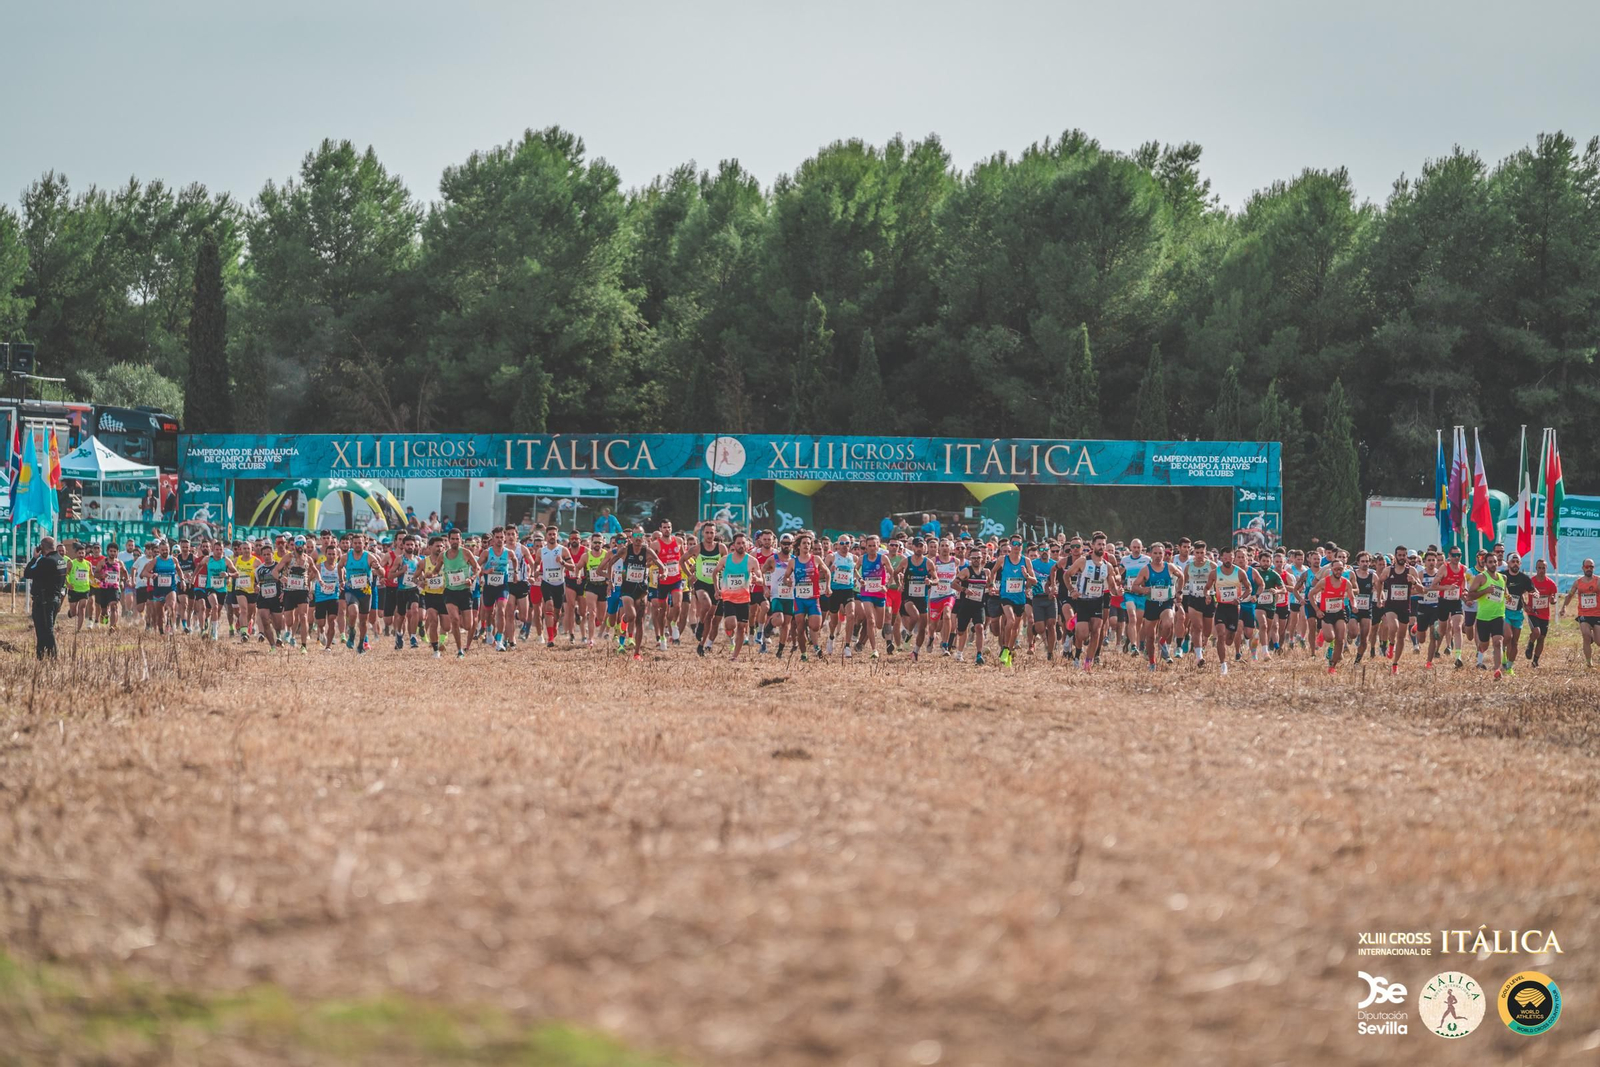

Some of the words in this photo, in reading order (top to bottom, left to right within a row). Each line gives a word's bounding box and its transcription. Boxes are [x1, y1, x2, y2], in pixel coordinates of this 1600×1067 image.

[253, 447, 300, 456] ANDALUCÍA
[331, 440, 410, 468] XLIII
[412, 440, 476, 458] CROSS
[504, 434, 658, 470] ITÁLICA
[850, 444, 916, 460] CROSS
[768, 442, 850, 470] XLIII
[944, 438, 1098, 476] ITÁLICA
[1152, 455, 1208, 463] CAMPEONATO
[1220, 454, 1268, 464] ANDALUCÍA
[412, 458, 499, 468] INTERNACIONAL
[851, 460, 938, 472] INTERNACIONAL
[330, 469, 406, 478] INTERNATIONAL
[408, 469, 437, 478] CROSS
[438, 468, 484, 478] COUNTRY
[767, 470, 844, 480] INTERNATIONAL
[846, 471, 876, 480] CROSS
[876, 472, 922, 481] COUNTRY
[1566, 527, 1598, 537] Sevilla
